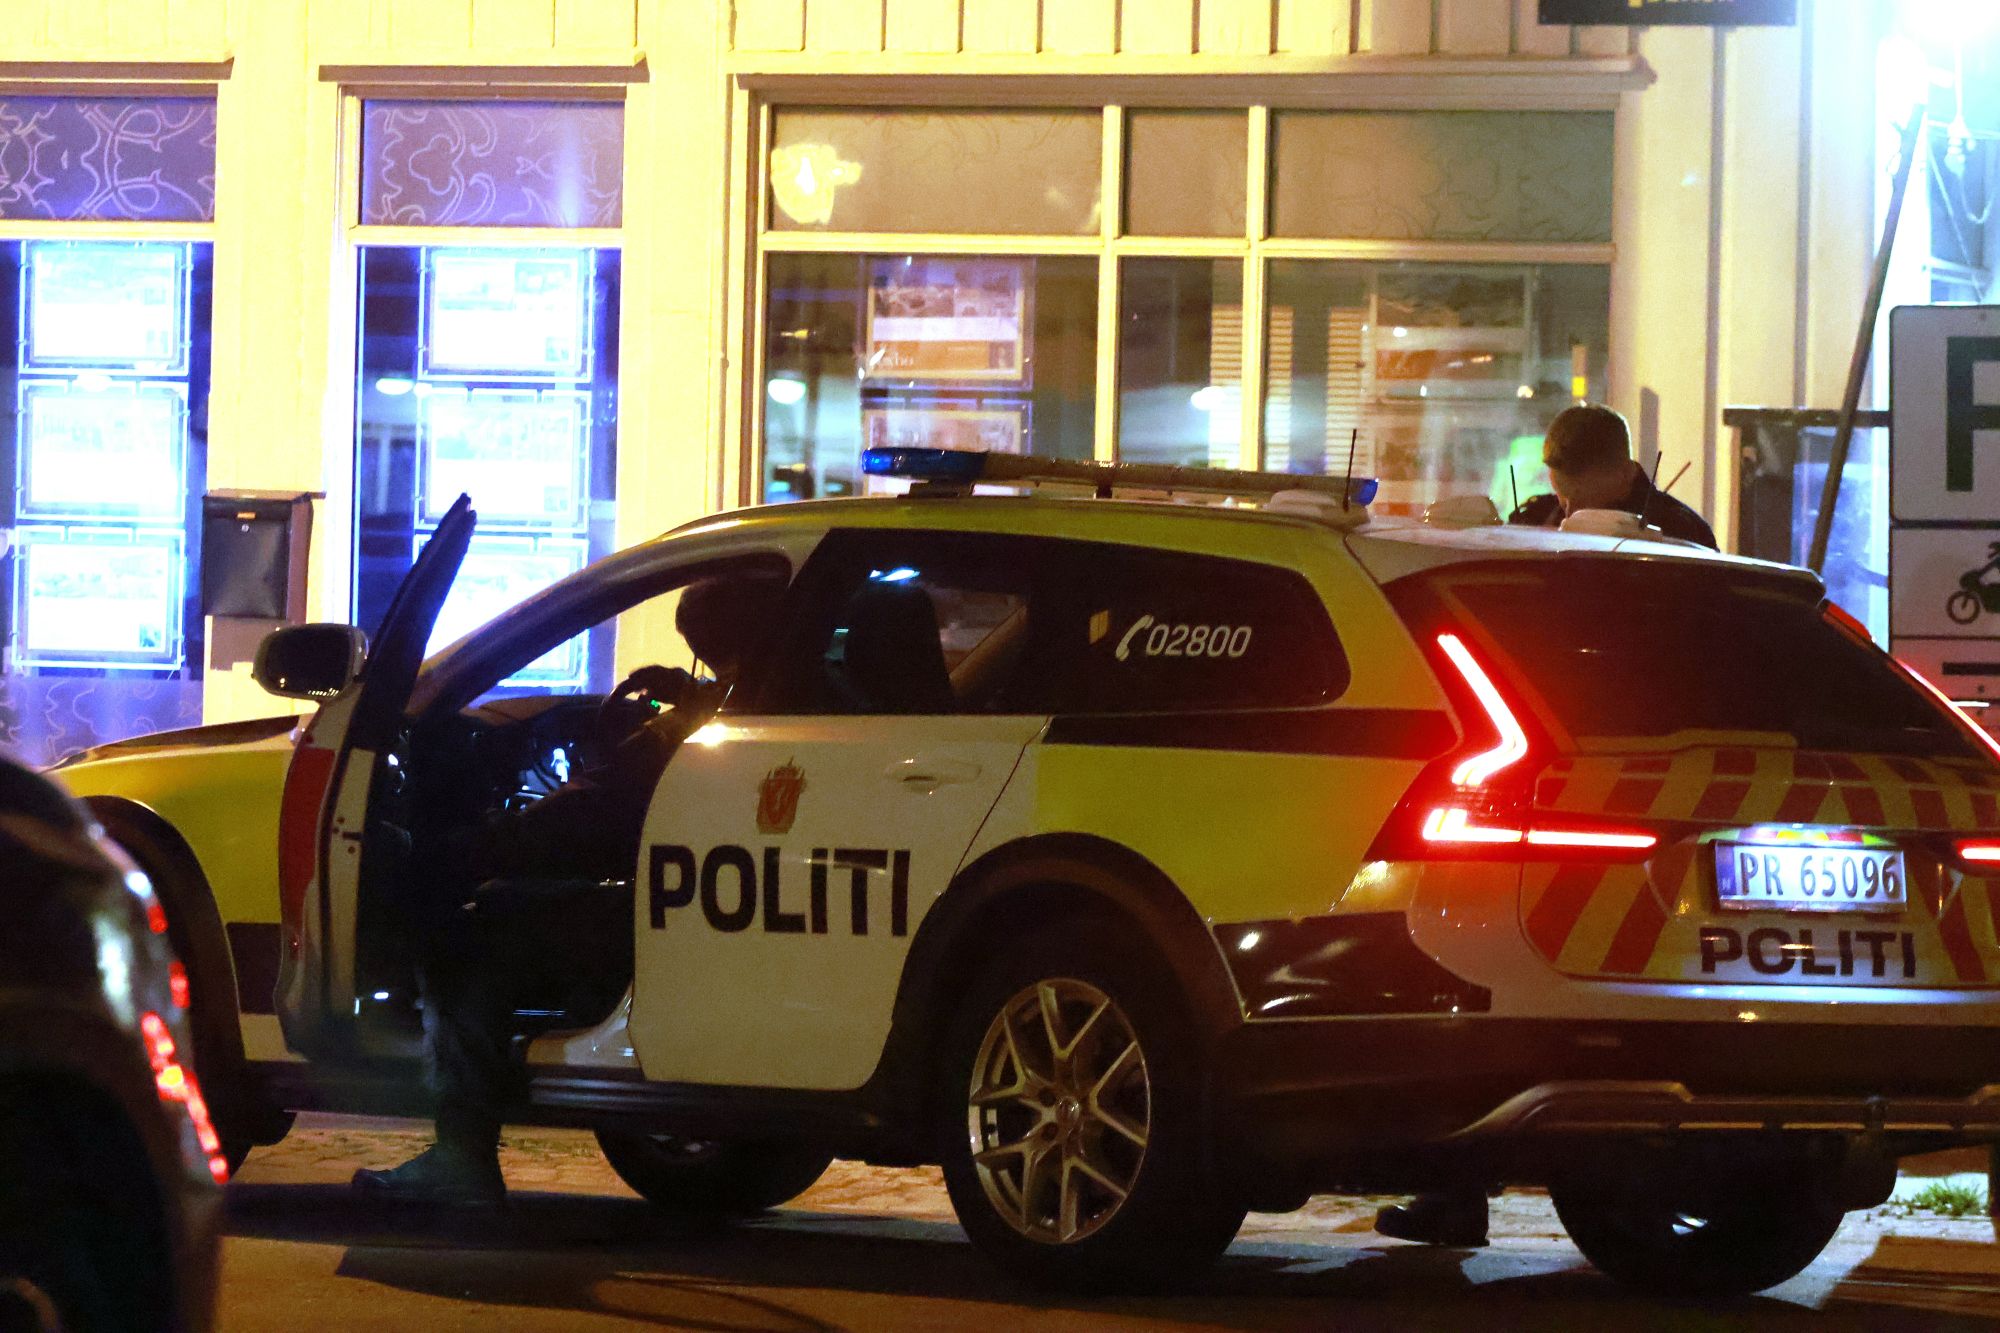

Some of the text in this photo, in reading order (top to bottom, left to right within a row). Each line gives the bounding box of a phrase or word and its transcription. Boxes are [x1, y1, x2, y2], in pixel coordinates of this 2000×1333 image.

[1145, 624, 1252, 657] 02800
[649, 844, 911, 937] POLITI
[1740, 852, 1899, 898] PR 65096
[1699, 927, 1916, 978] POLITI
